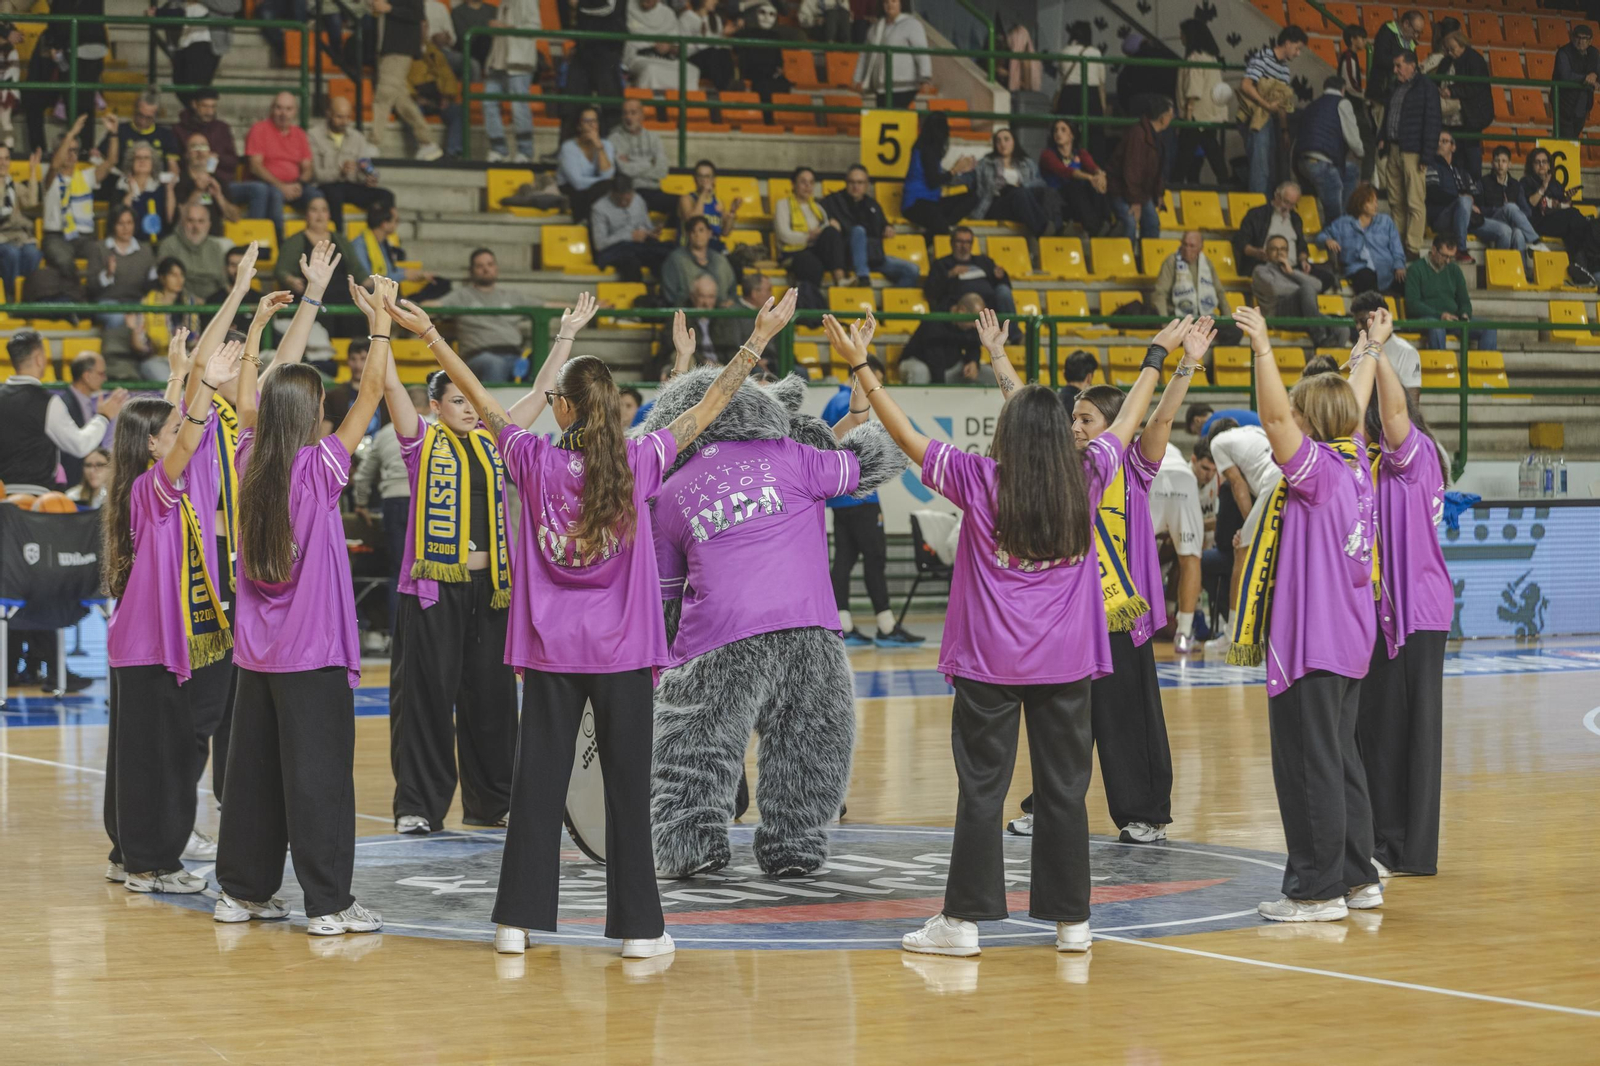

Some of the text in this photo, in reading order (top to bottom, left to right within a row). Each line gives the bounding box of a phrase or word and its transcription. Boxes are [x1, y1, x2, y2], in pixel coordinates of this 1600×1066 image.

[877, 123, 902, 167] 5
[1550, 151, 1569, 188] 6
[677, 463, 771, 505] CUATRO
[682, 472, 776, 518] PASOS
[427, 542, 456, 556] 32005
